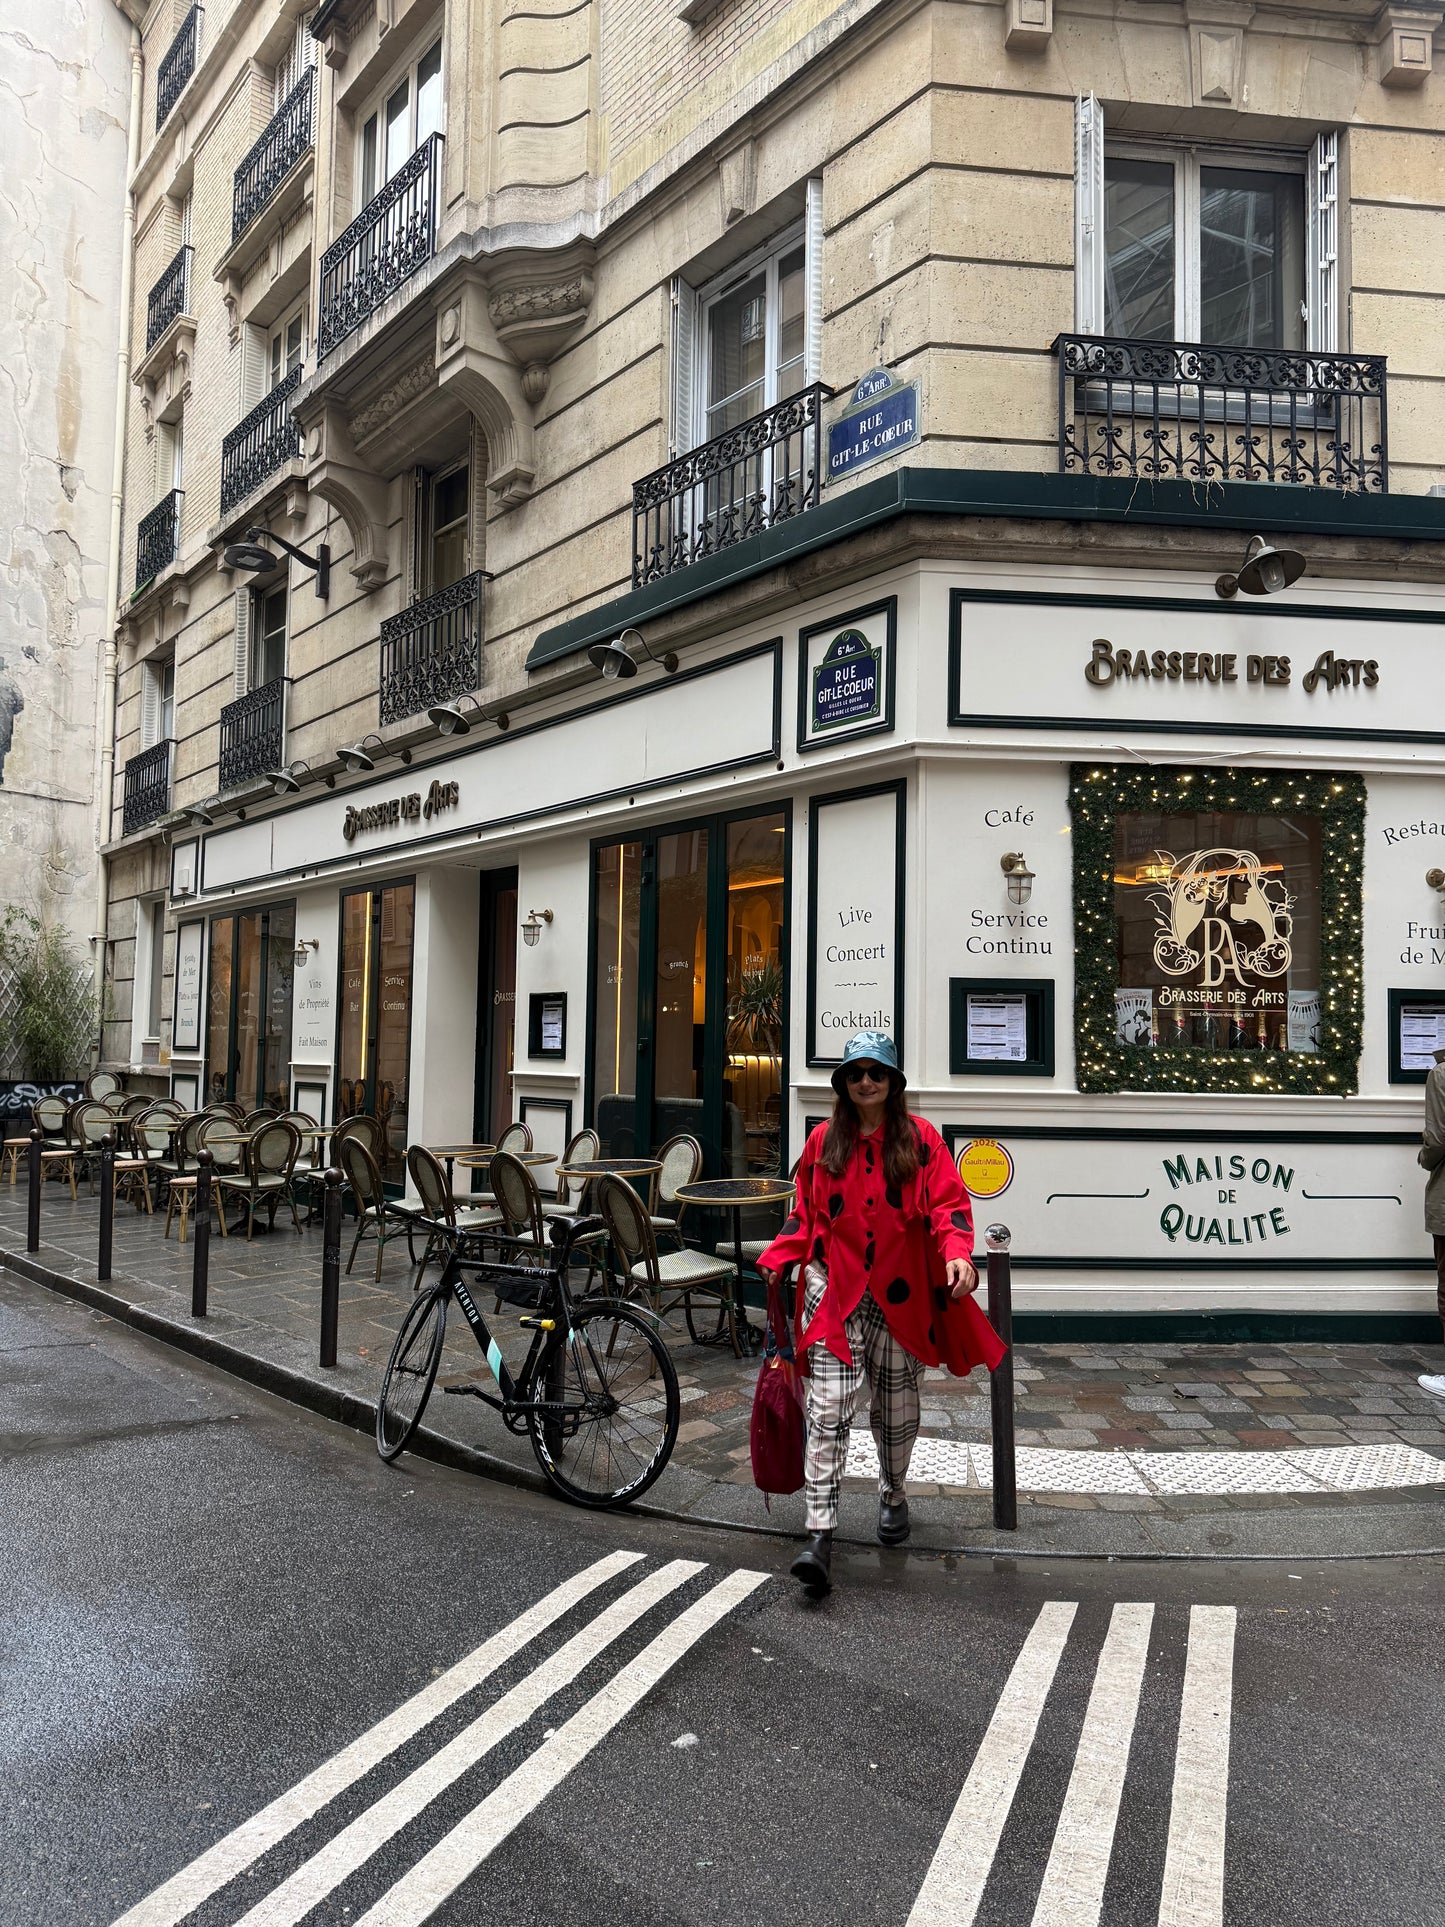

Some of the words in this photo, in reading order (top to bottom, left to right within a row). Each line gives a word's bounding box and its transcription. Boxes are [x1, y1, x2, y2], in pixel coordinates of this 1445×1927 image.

[859, 412, 883, 435] RUE
[835, 665, 857, 683] RUE
[1084, 638, 1238, 686] BRASSERIE
[1246, 654, 1292, 685] DES
[1302, 650, 1379, 693] ARTS
[343, 799, 400, 841] BRASSERIE
[401, 792, 421, 818] DES
[423, 780, 459, 820] ARTS
[984, 805, 1034, 828] Café
[838, 906, 872, 928] Live
[970, 909, 1048, 928] Service
[826, 944, 886, 962] Concert
[966, 935, 1053, 955] Continu
[745, 954, 763, 965] Plats
[1400, 946, 1423, 964] de
[309, 979, 322, 989] Vins
[348, 978, 361, 988] Café
[384, 974, 405, 987] Service
[298, 1000, 305, 1009] de
[1158, 985, 1224, 1006] BRASSERIE
[1227, 991, 1247, 1004] DES
[1251, 988, 1285, 1007] ARTS
[350, 1002, 359, 1012] Bar
[383, 1000, 405, 1011] Continu
[821, 1010, 891, 1028] Cocktails
[298, 1036, 309, 1047] Fait
[309, 1036, 328, 1047] Maison
[973, 1138, 996, 1148] 2025
[1162, 1153, 1295, 1193] MAISON
[1218, 1189, 1237, 1204] DE
[453, 1281, 480, 1324] AVENTON
